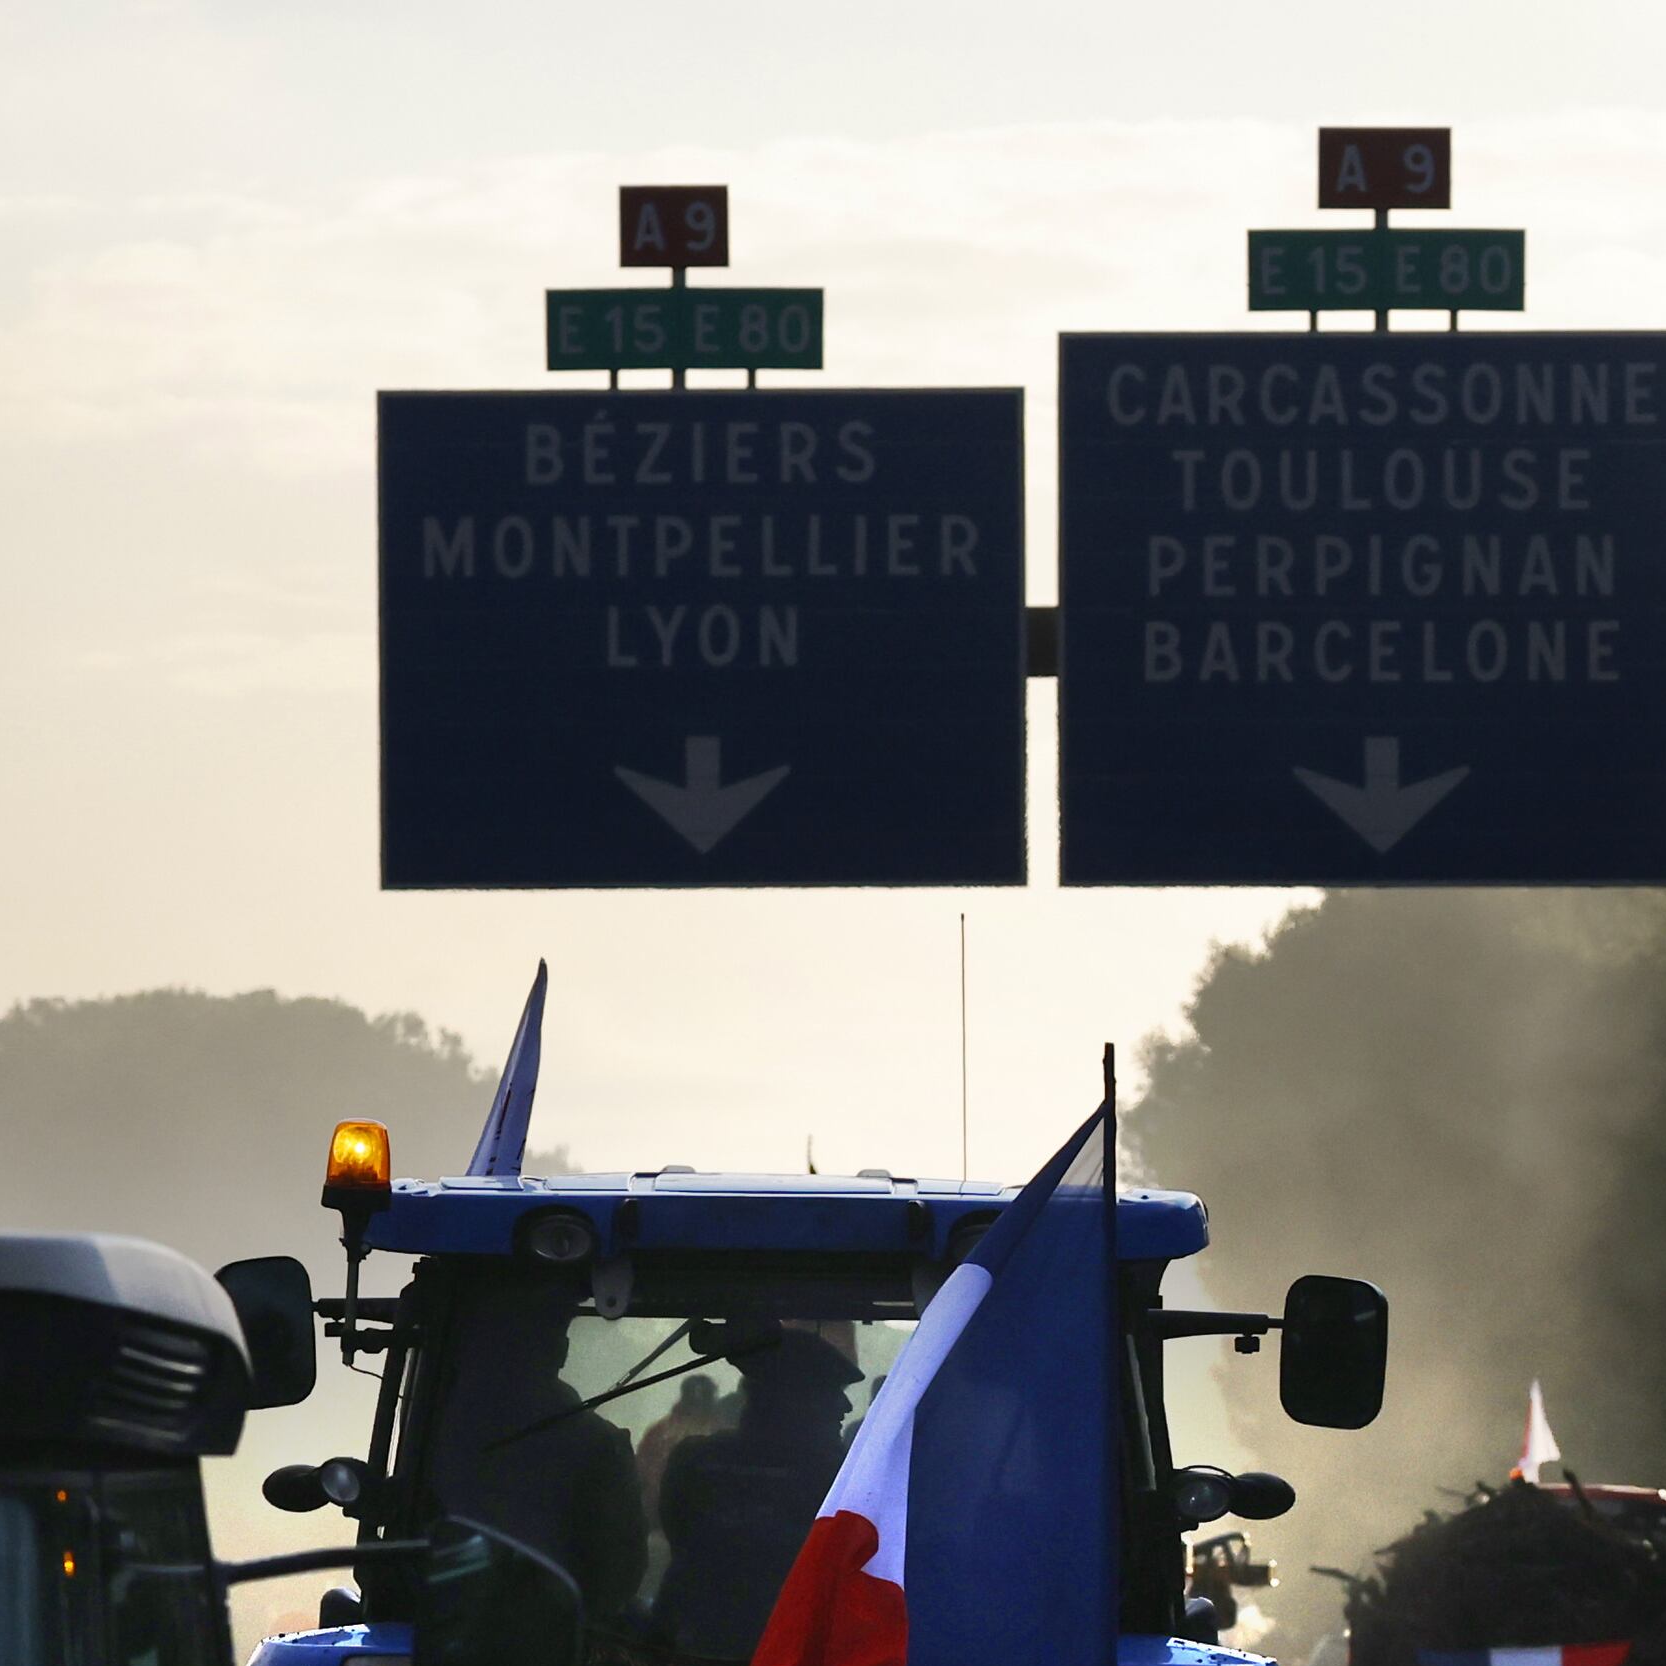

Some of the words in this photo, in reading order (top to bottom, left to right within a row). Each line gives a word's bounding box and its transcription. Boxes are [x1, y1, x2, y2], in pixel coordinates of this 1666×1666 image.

[1336, 143, 1369, 193] A
[1402, 143, 1435, 194] 9
[634, 201, 666, 252] A
[684, 200, 716, 252] 9
[1260, 246, 1286, 295] E
[1307, 245, 1367, 295] 15
[1396, 246, 1421, 294] E
[1439, 244, 1511, 295] 80
[559, 304, 584, 353] E
[604, 304, 668, 353] 15
[694, 304, 720, 352] E
[739, 303, 811, 353] 80
[1105, 358, 1658, 428] CARCASSONNE
[525, 408, 877, 486] BÉZIERS
[1170, 445, 1593, 513] TOULOUSE
[422, 513, 980, 579] MONTPELLIER
[1147, 532, 1616, 598] PERPIGNAN
[607, 603, 799, 668] LYON
[1143, 618, 1621, 684] BARCELONE
